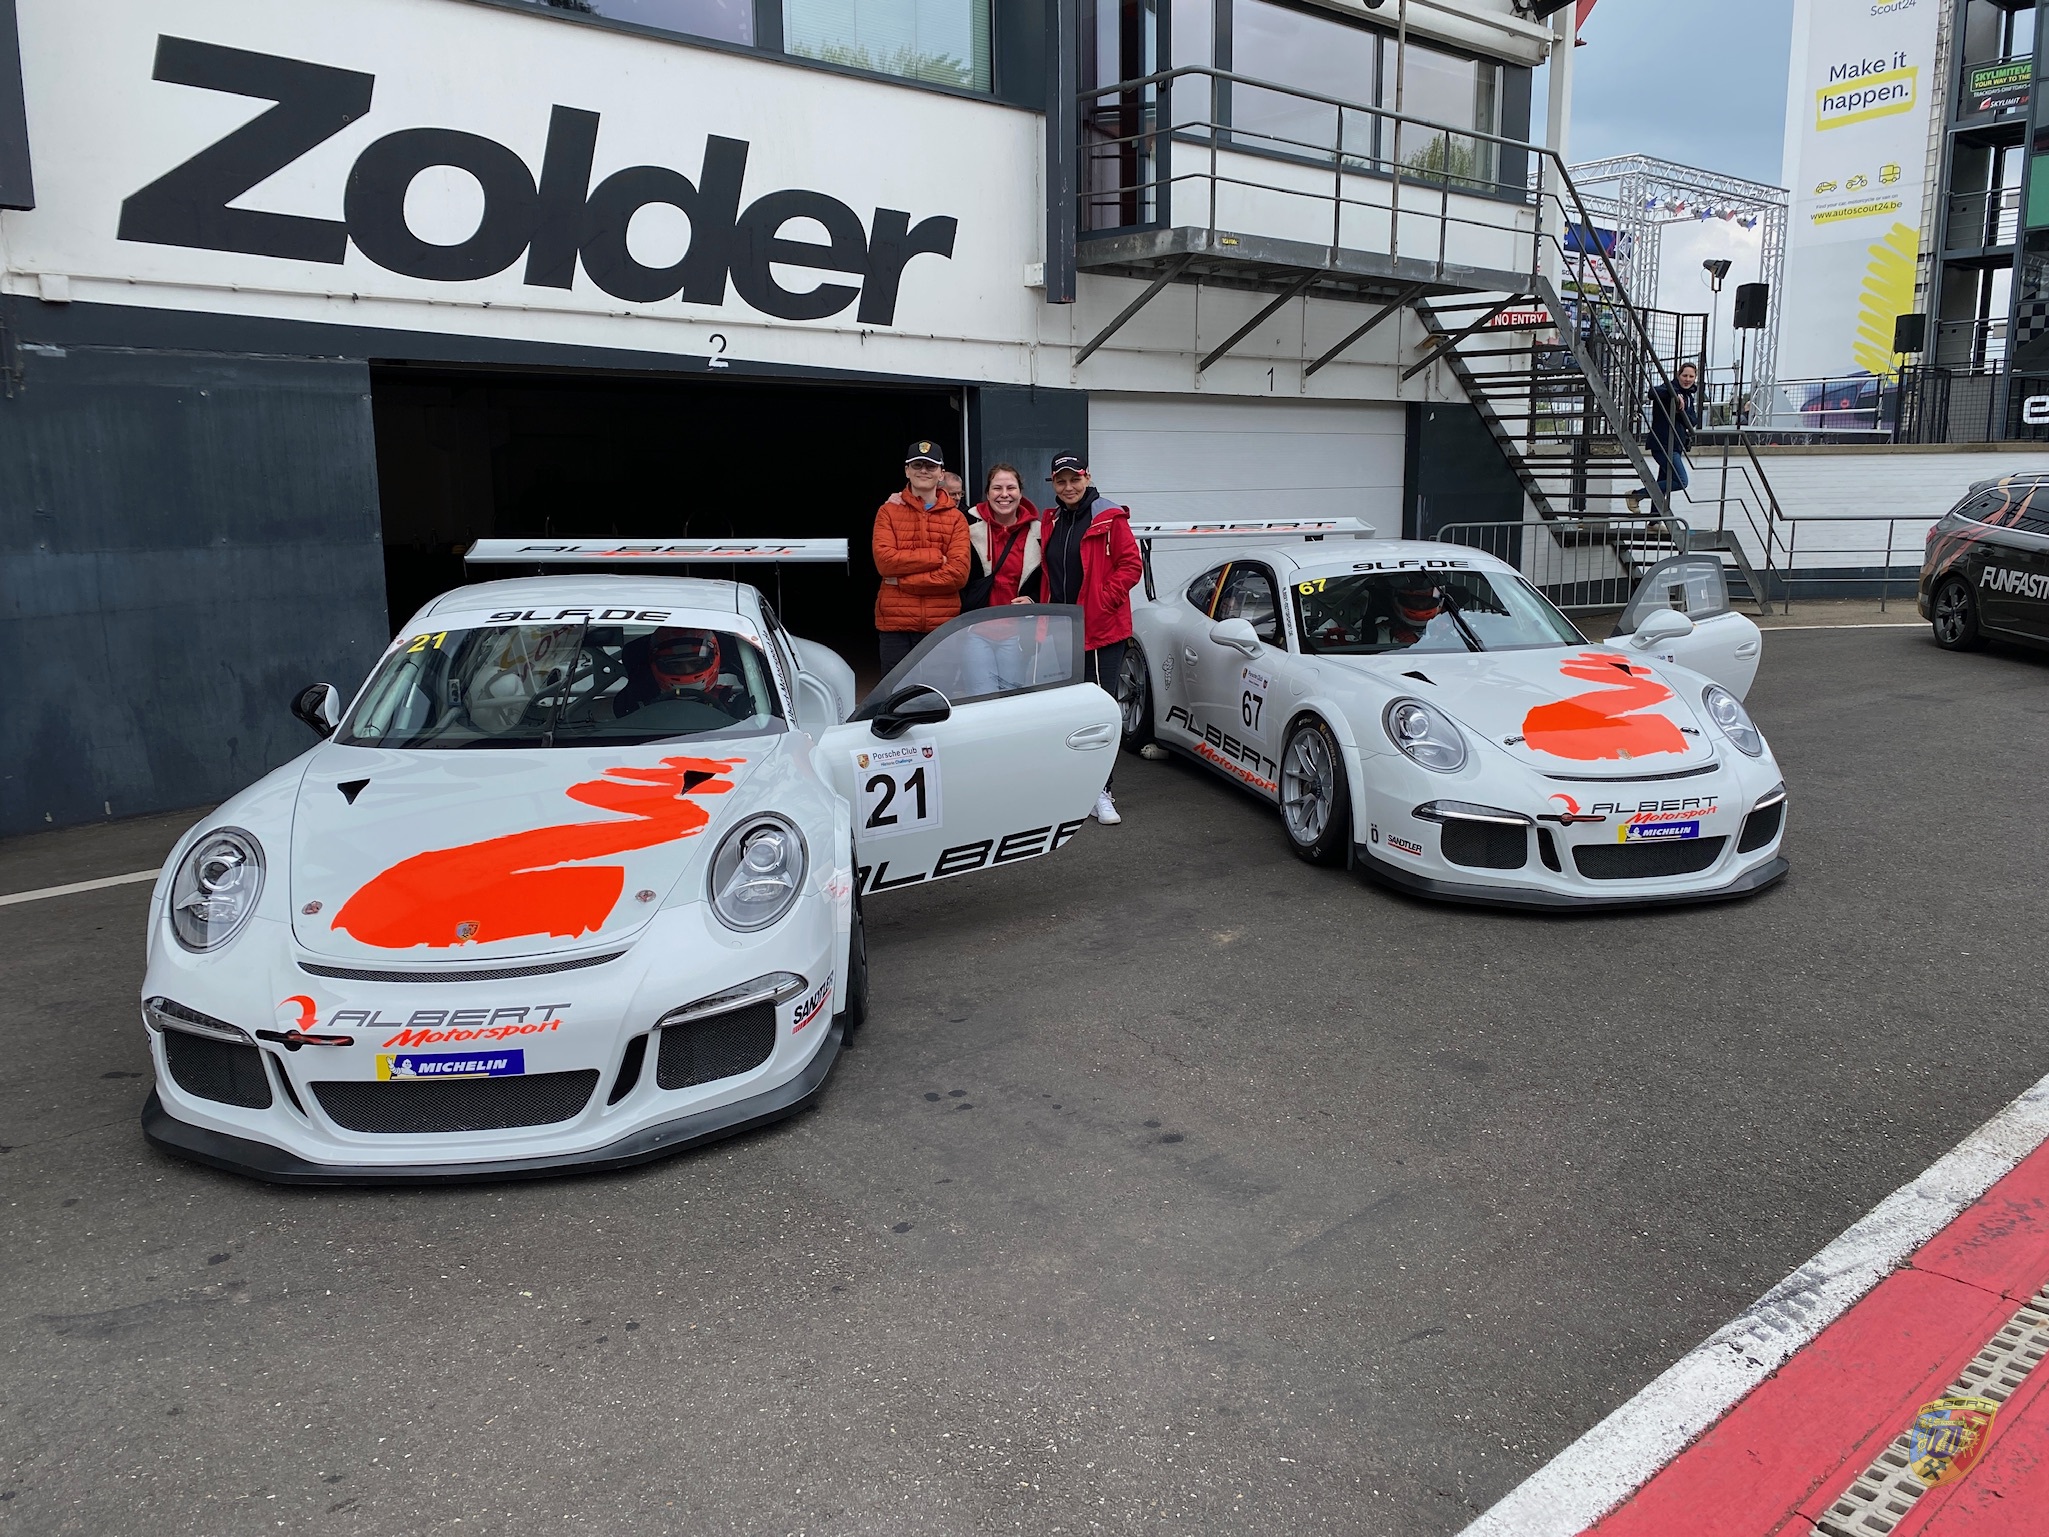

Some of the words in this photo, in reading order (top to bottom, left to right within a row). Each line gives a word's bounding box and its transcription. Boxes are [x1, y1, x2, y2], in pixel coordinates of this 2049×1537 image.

[1870, 0, 1916, 16] Scout24
[1829, 59, 1886, 82] Make
[1893, 51, 1907, 69] it
[1974, 79, 1993, 89] YOUR
[1993, 77, 2008, 85] WAY
[1823, 83, 1909, 111] happen.
[1990, 96, 2021, 108] SKYLIMIT
[116, 33, 958, 326] Zolder
[1810, 201, 1903, 220] www.autoscout24.be
[1494, 313, 1509, 326] NO
[1512, 313, 1544, 326] ENTRY
[708, 333, 729, 368] 2
[1267, 366, 1274, 392] 1
[516, 545, 806, 553] ALBERT
[1299, 578, 1328, 595] 67
[406, 631, 448, 654] 21
[1242, 689, 1263, 732] 67
[1165, 705, 1278, 780] ALBERT
[872, 750, 900, 761] Porsche
[901, 746, 918, 756] Club
[1192, 740, 1278, 793] Motorsport
[865, 766, 927, 829] 21
[1591, 796, 1718, 814] ALBERT
[1625, 805, 1718, 824] Motorsport
[1642, 826, 1692, 837] MICHELIN
[1387, 834, 1423, 853] SANDTLER
[327, 1002, 573, 1028] ALBERT
[382, 1019, 565, 1048] Motorsport
[418, 1058, 508, 1074] MICHELIN
